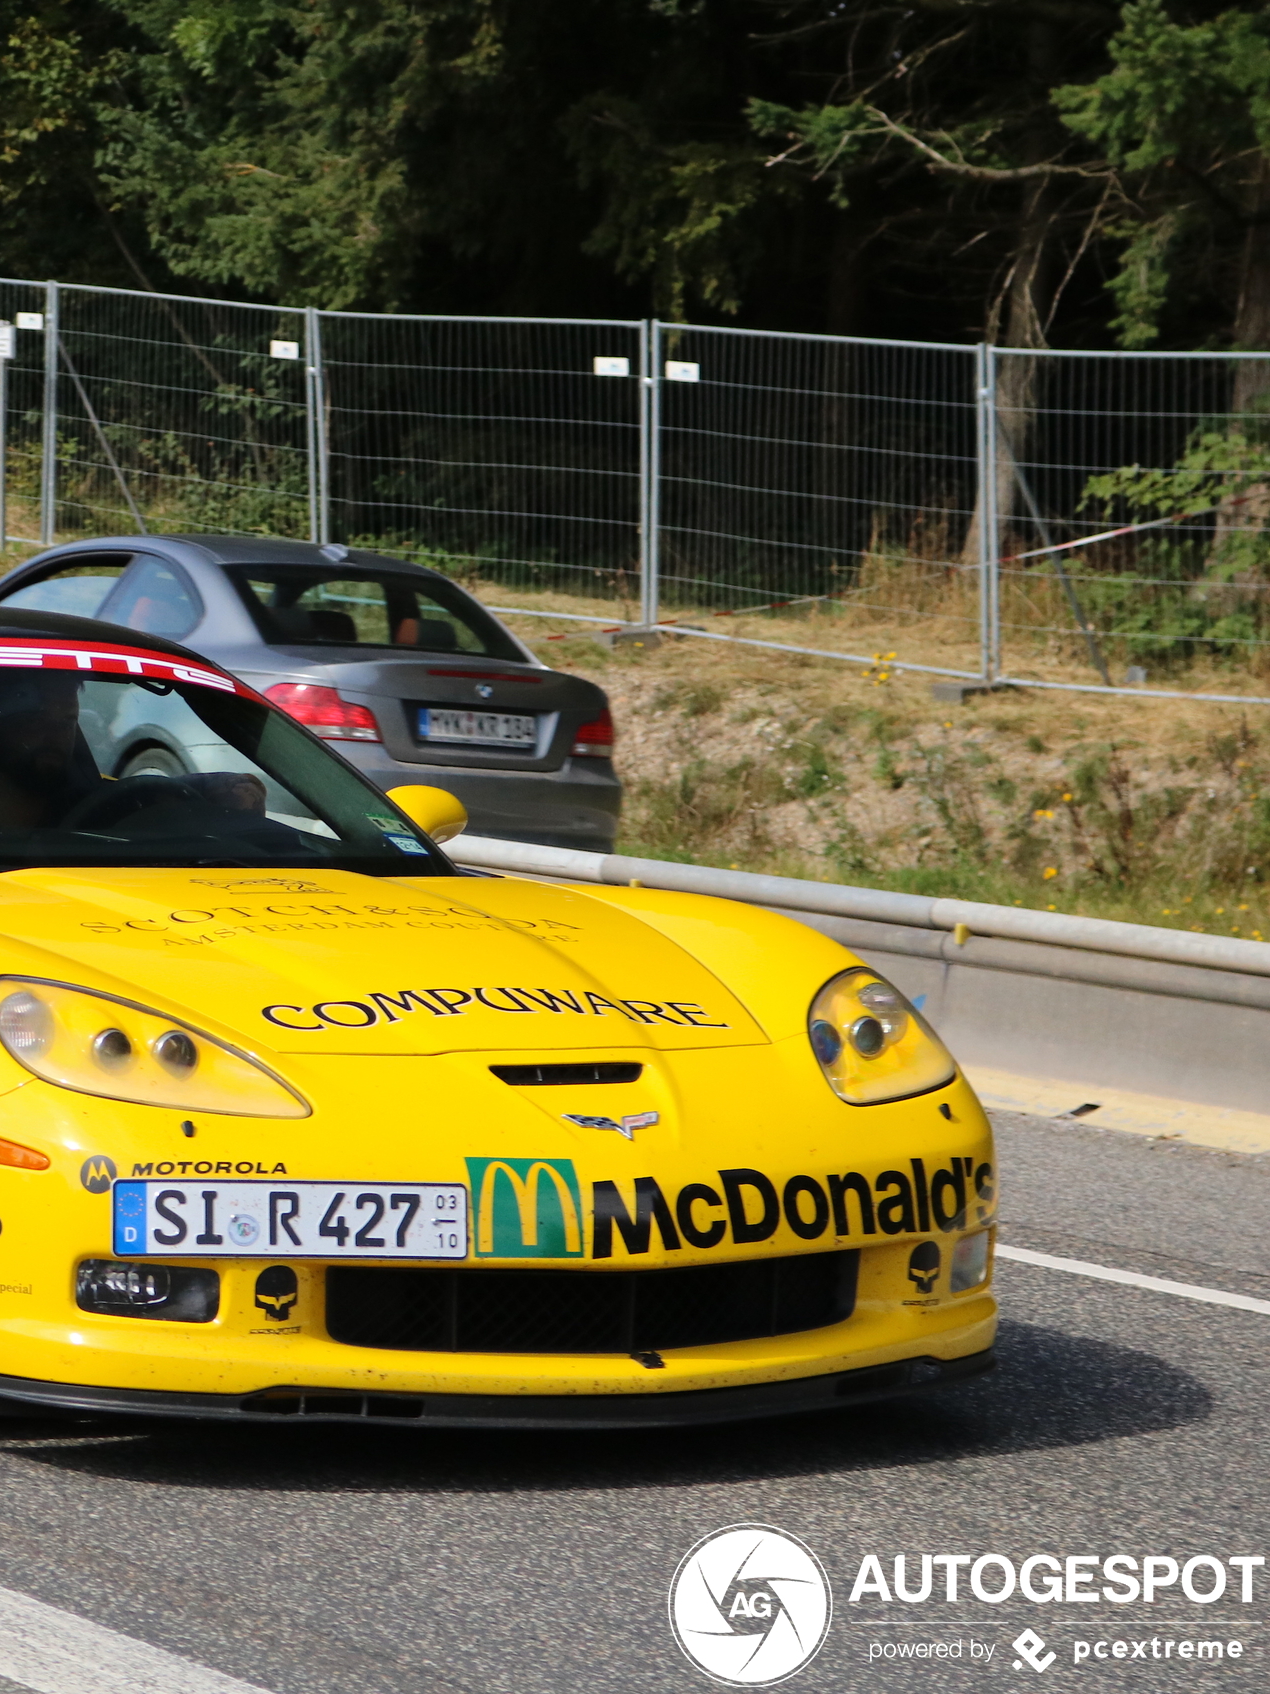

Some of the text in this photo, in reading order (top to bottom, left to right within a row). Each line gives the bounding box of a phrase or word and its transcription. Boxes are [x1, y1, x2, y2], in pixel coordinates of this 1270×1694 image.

[261, 987, 729, 1032] COMPUWARE
[131, 1161, 288, 1177] MOTOROLA
[436, 1194, 457, 1210] 03
[592, 1157, 995, 1259] McDonald's
[153, 1190, 421, 1248] SI R 427
[124, 1227, 137, 1243] D
[439, 1233, 458, 1249] 10
